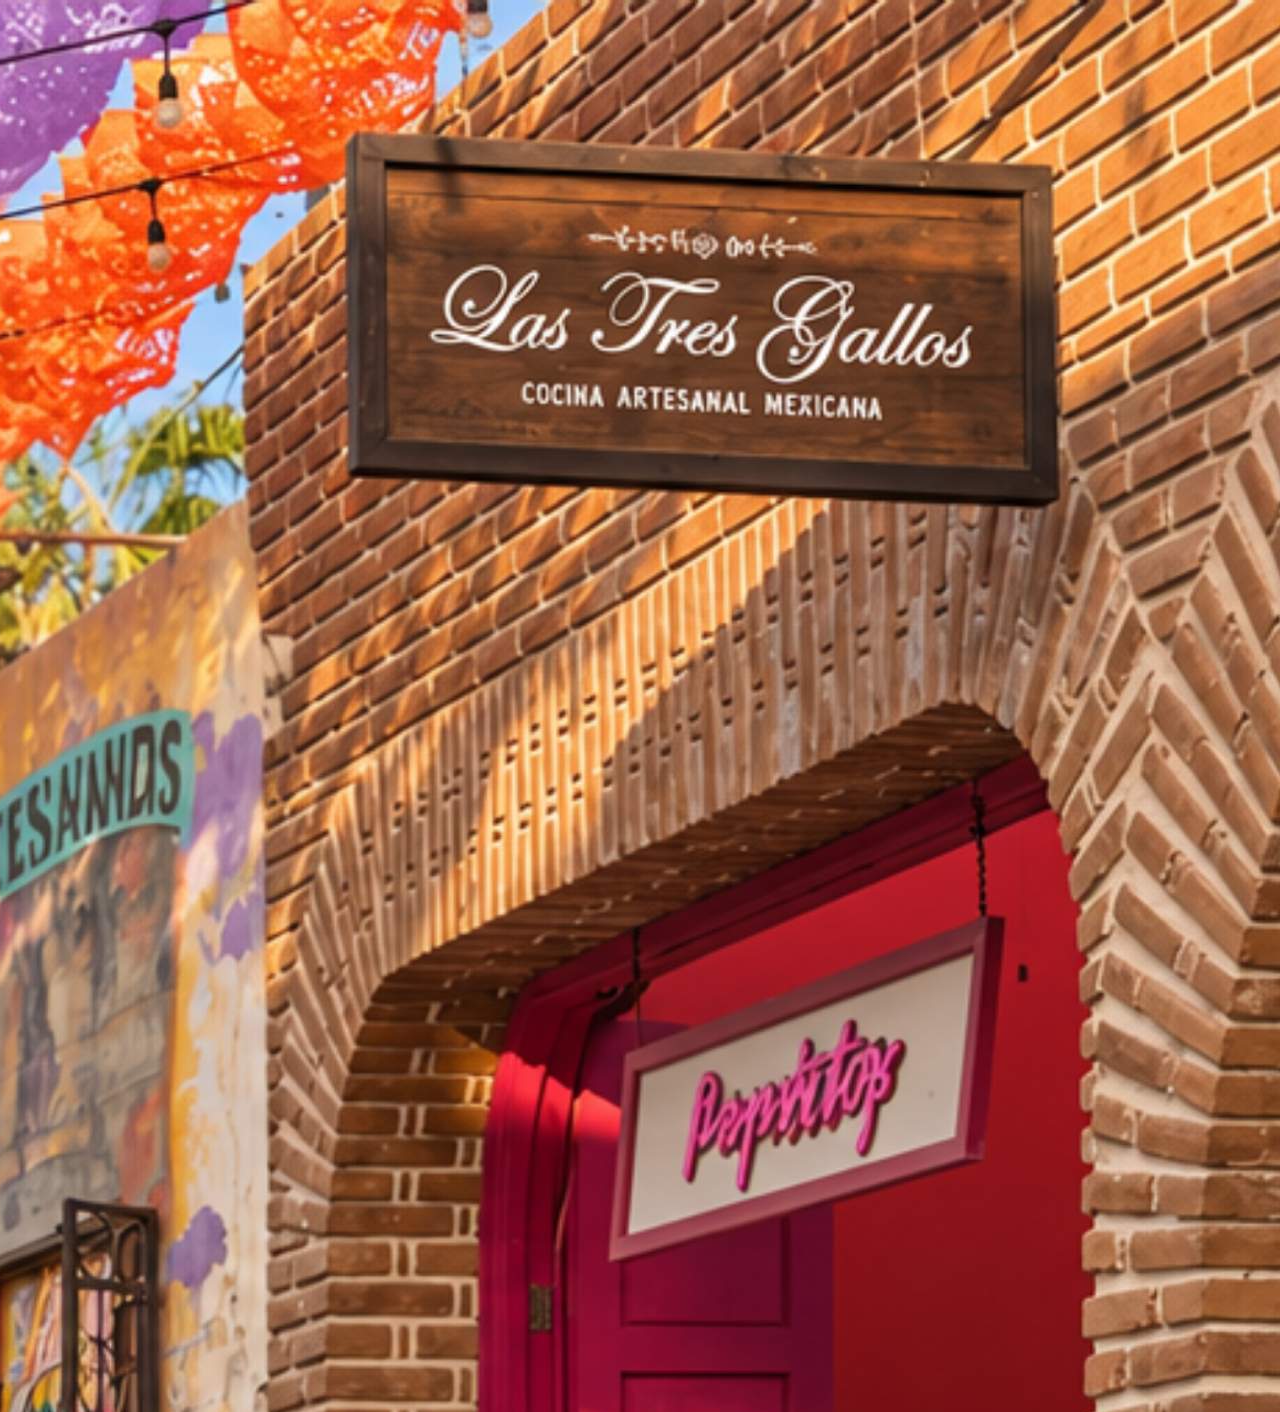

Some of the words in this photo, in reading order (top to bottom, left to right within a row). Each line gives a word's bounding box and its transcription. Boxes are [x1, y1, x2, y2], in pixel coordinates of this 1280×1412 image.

[429, 264, 571, 352] Las
[590, 272, 738, 358] Tres
[756, 275, 973, 383] Gallos
[521, 381, 605, 408] COCINA
[616, 386, 751, 415] ARTESANAL
[764, 392, 883, 421] MEXICANA
